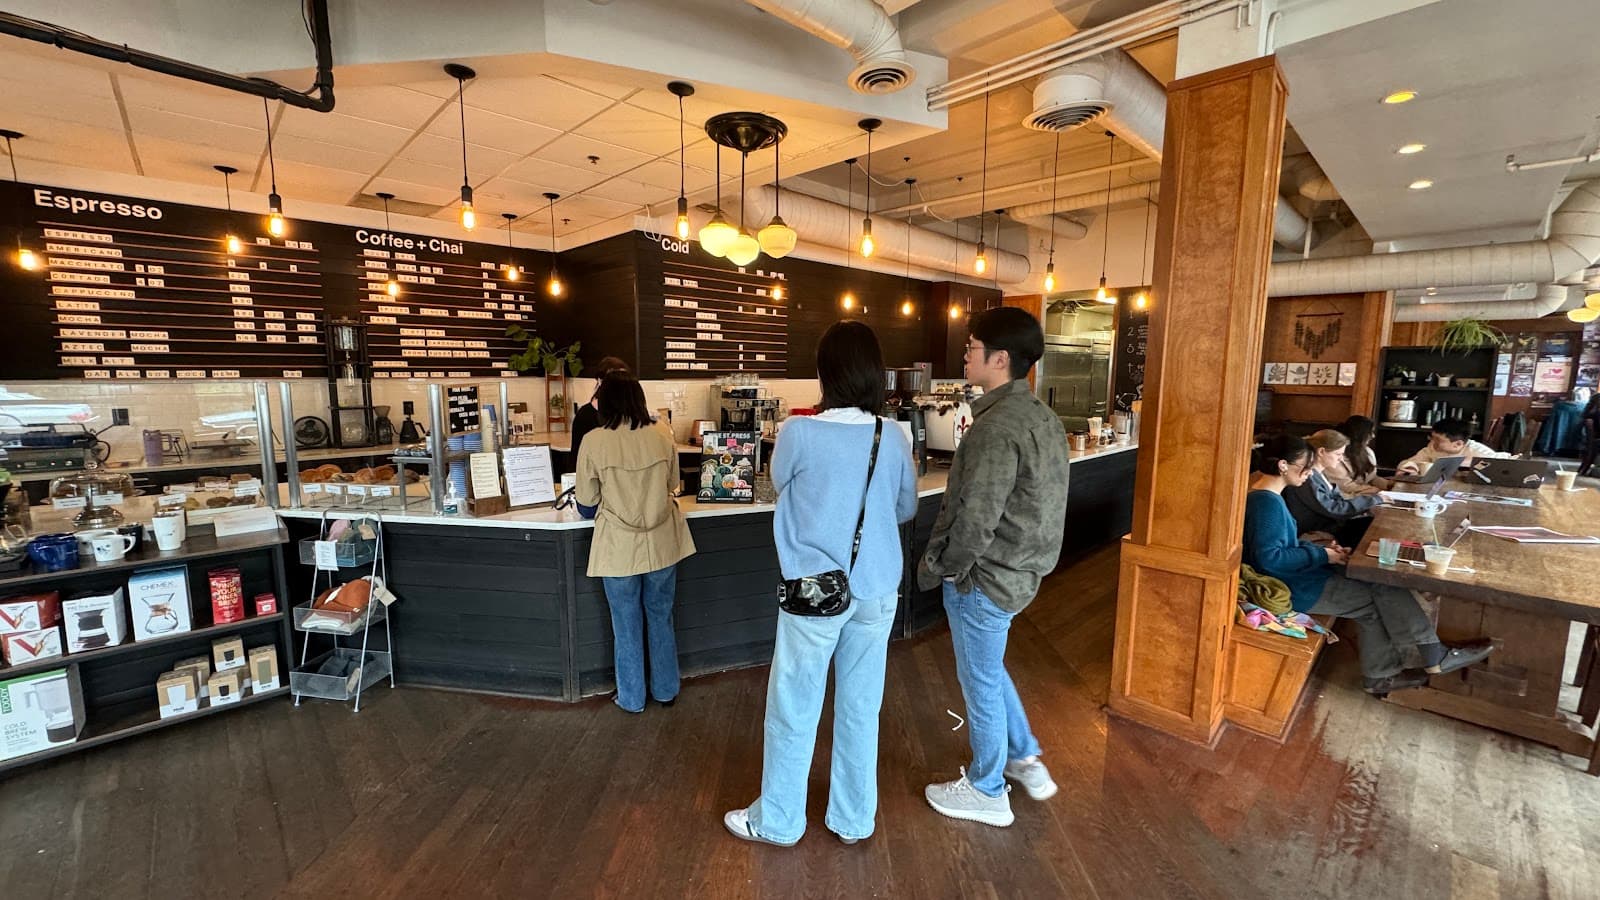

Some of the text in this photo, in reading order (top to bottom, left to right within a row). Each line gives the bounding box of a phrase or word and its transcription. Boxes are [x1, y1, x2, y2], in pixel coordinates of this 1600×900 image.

[34, 188, 163, 220] Espresso
[46, 230, 112, 242] ESPRESSO
[355, 230, 414, 249] Coffee
[429, 239, 464, 255] Chai
[661, 238, 690, 254] Cold
[48, 246, 122, 257] AMERICANO
[50, 259, 124, 270] MACCHIATO
[52, 273, 110, 283] CORTADO
[54, 288, 135, 298] CAPPUCCINO
[58, 302, 97, 310] LATTE
[1128, 327, 1134, 337] 2
[140, 580, 174, 591] CHEMEX
[4, 721, 27, 731] COLD
[4, 727, 28, 736] BREW
[6, 730, 37, 740] SYSTEM
